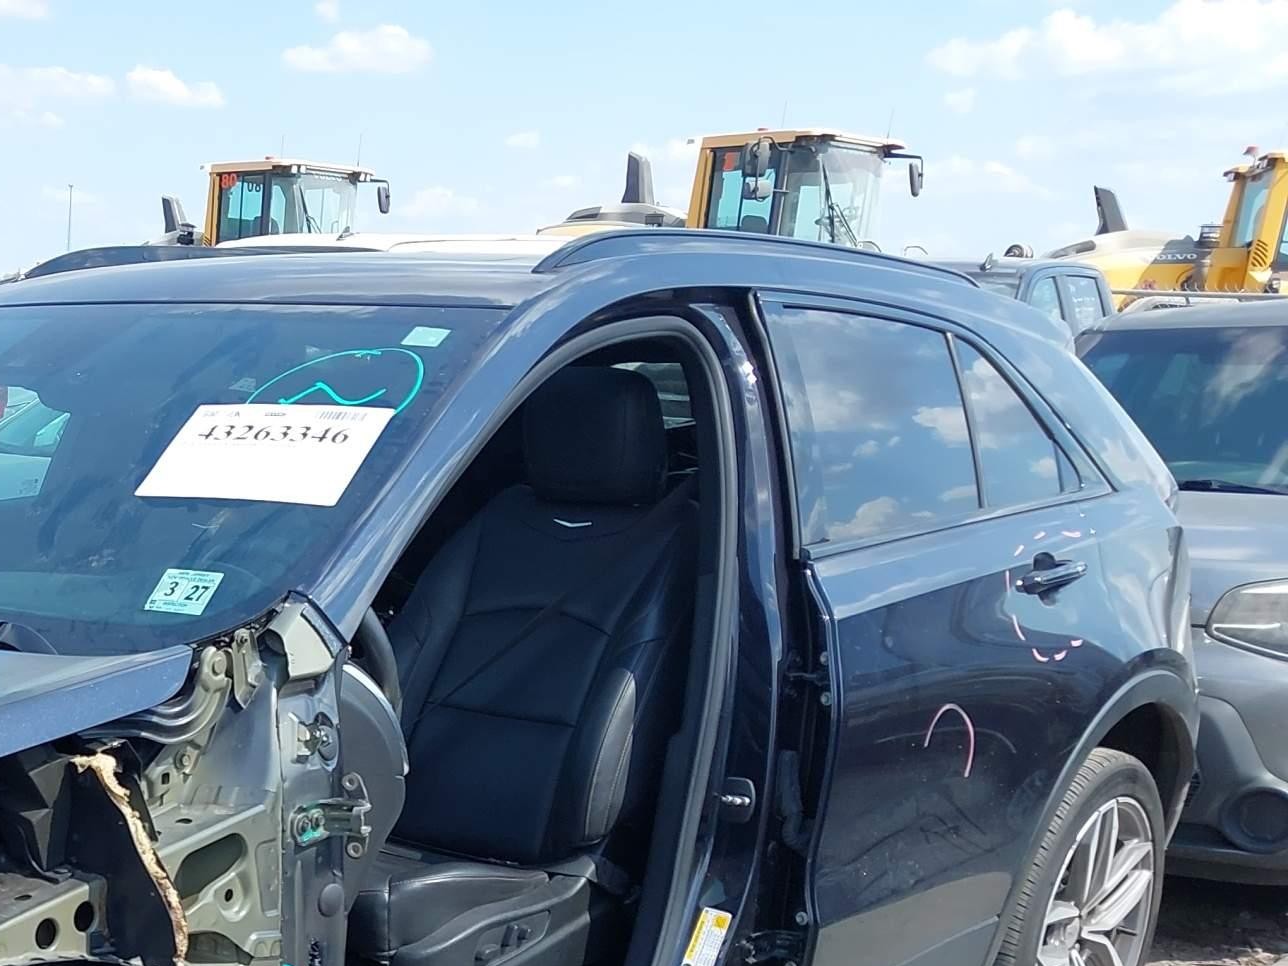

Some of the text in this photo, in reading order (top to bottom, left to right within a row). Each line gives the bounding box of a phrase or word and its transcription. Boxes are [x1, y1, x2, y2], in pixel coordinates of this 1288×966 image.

[198, 424, 351, 444] 43263346
[164, 581, 210, 602] 3 27
